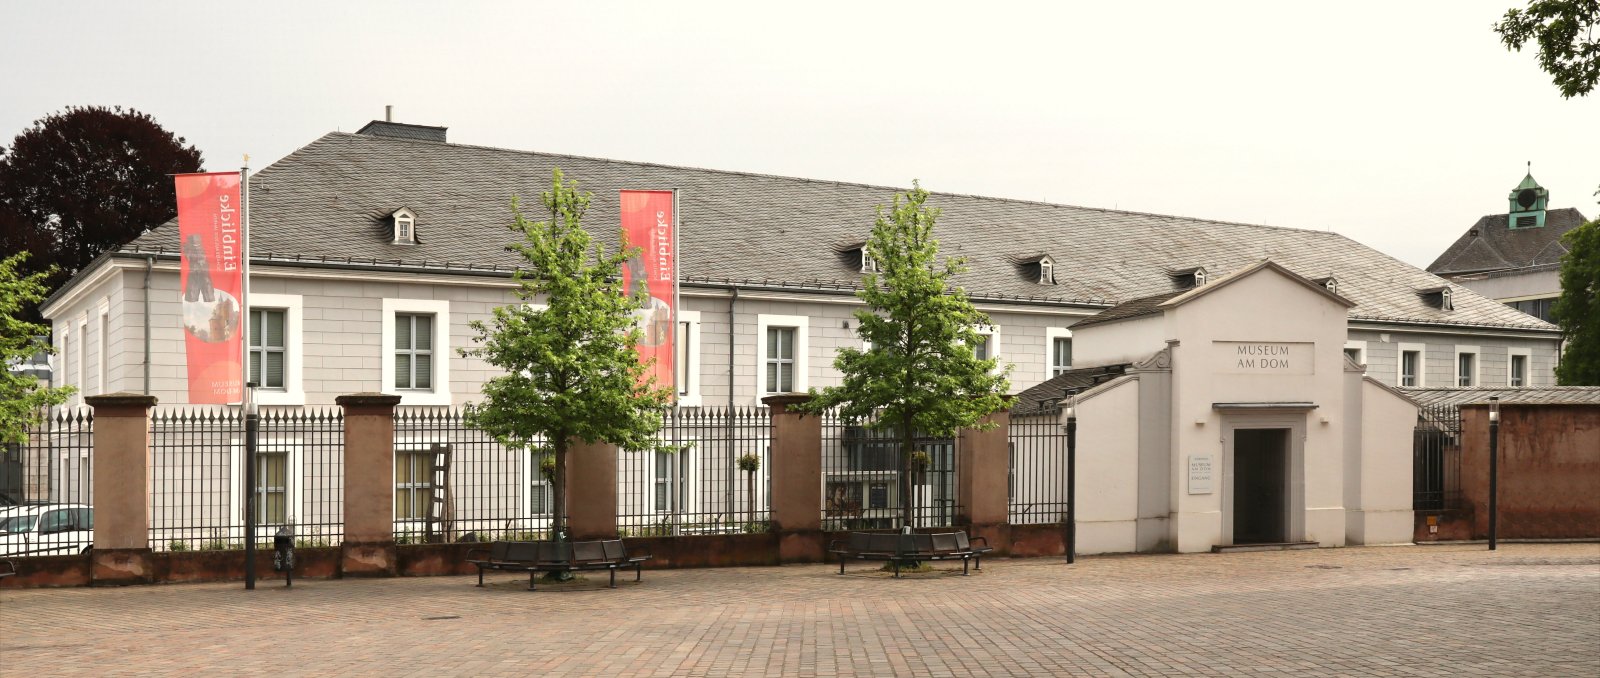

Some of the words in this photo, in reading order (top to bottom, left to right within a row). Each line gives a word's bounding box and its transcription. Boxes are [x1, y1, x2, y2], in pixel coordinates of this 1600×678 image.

[1238, 345, 1289, 355] MUSEUM
[1238, 359, 1255, 368] AM
[1261, 359, 1289, 368] DOM
